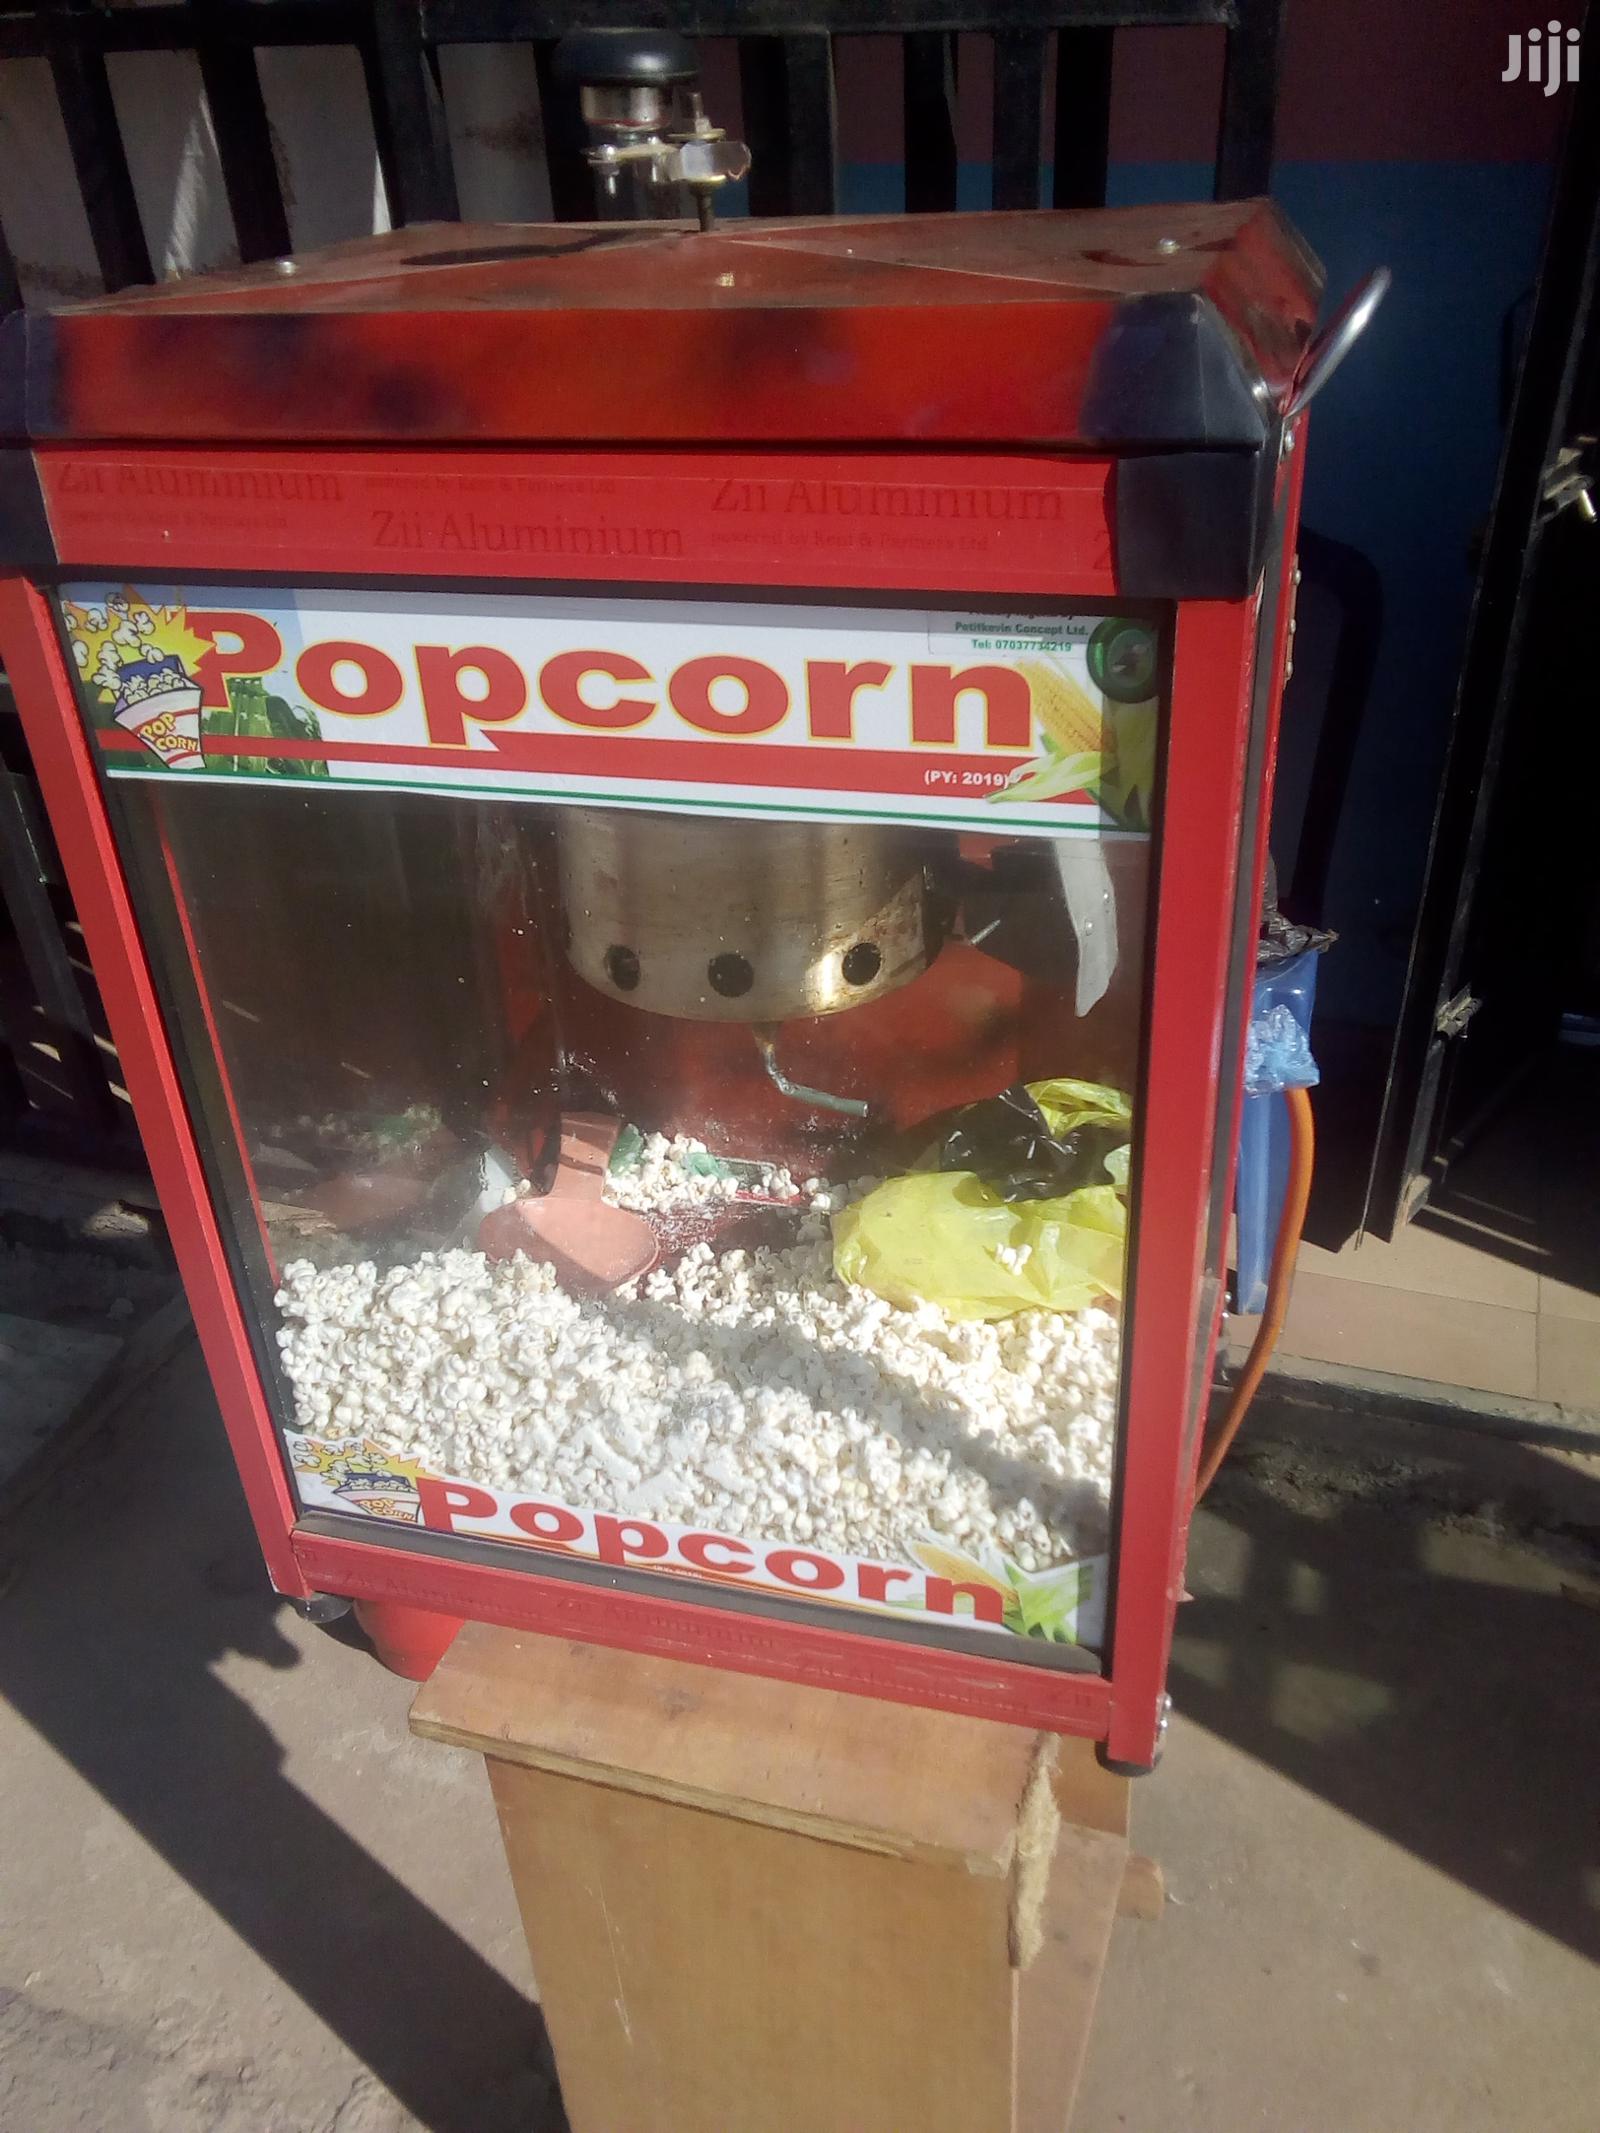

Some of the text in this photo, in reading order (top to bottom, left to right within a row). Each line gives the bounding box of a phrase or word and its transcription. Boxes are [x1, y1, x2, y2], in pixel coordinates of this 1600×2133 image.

[440, 510, 685, 557] Aluminium
[1016, 623, 1062, 636] Concept
[971, 639, 992, 650] Tel:
[168, 608, 1034, 751] Popcorn
[139, 711, 176, 741] POP
[155, 734, 199, 752] CORN
[924, 769, 1009, 790] (PY: 2019)
[415, 1476, 1005, 1626] Popcorn
